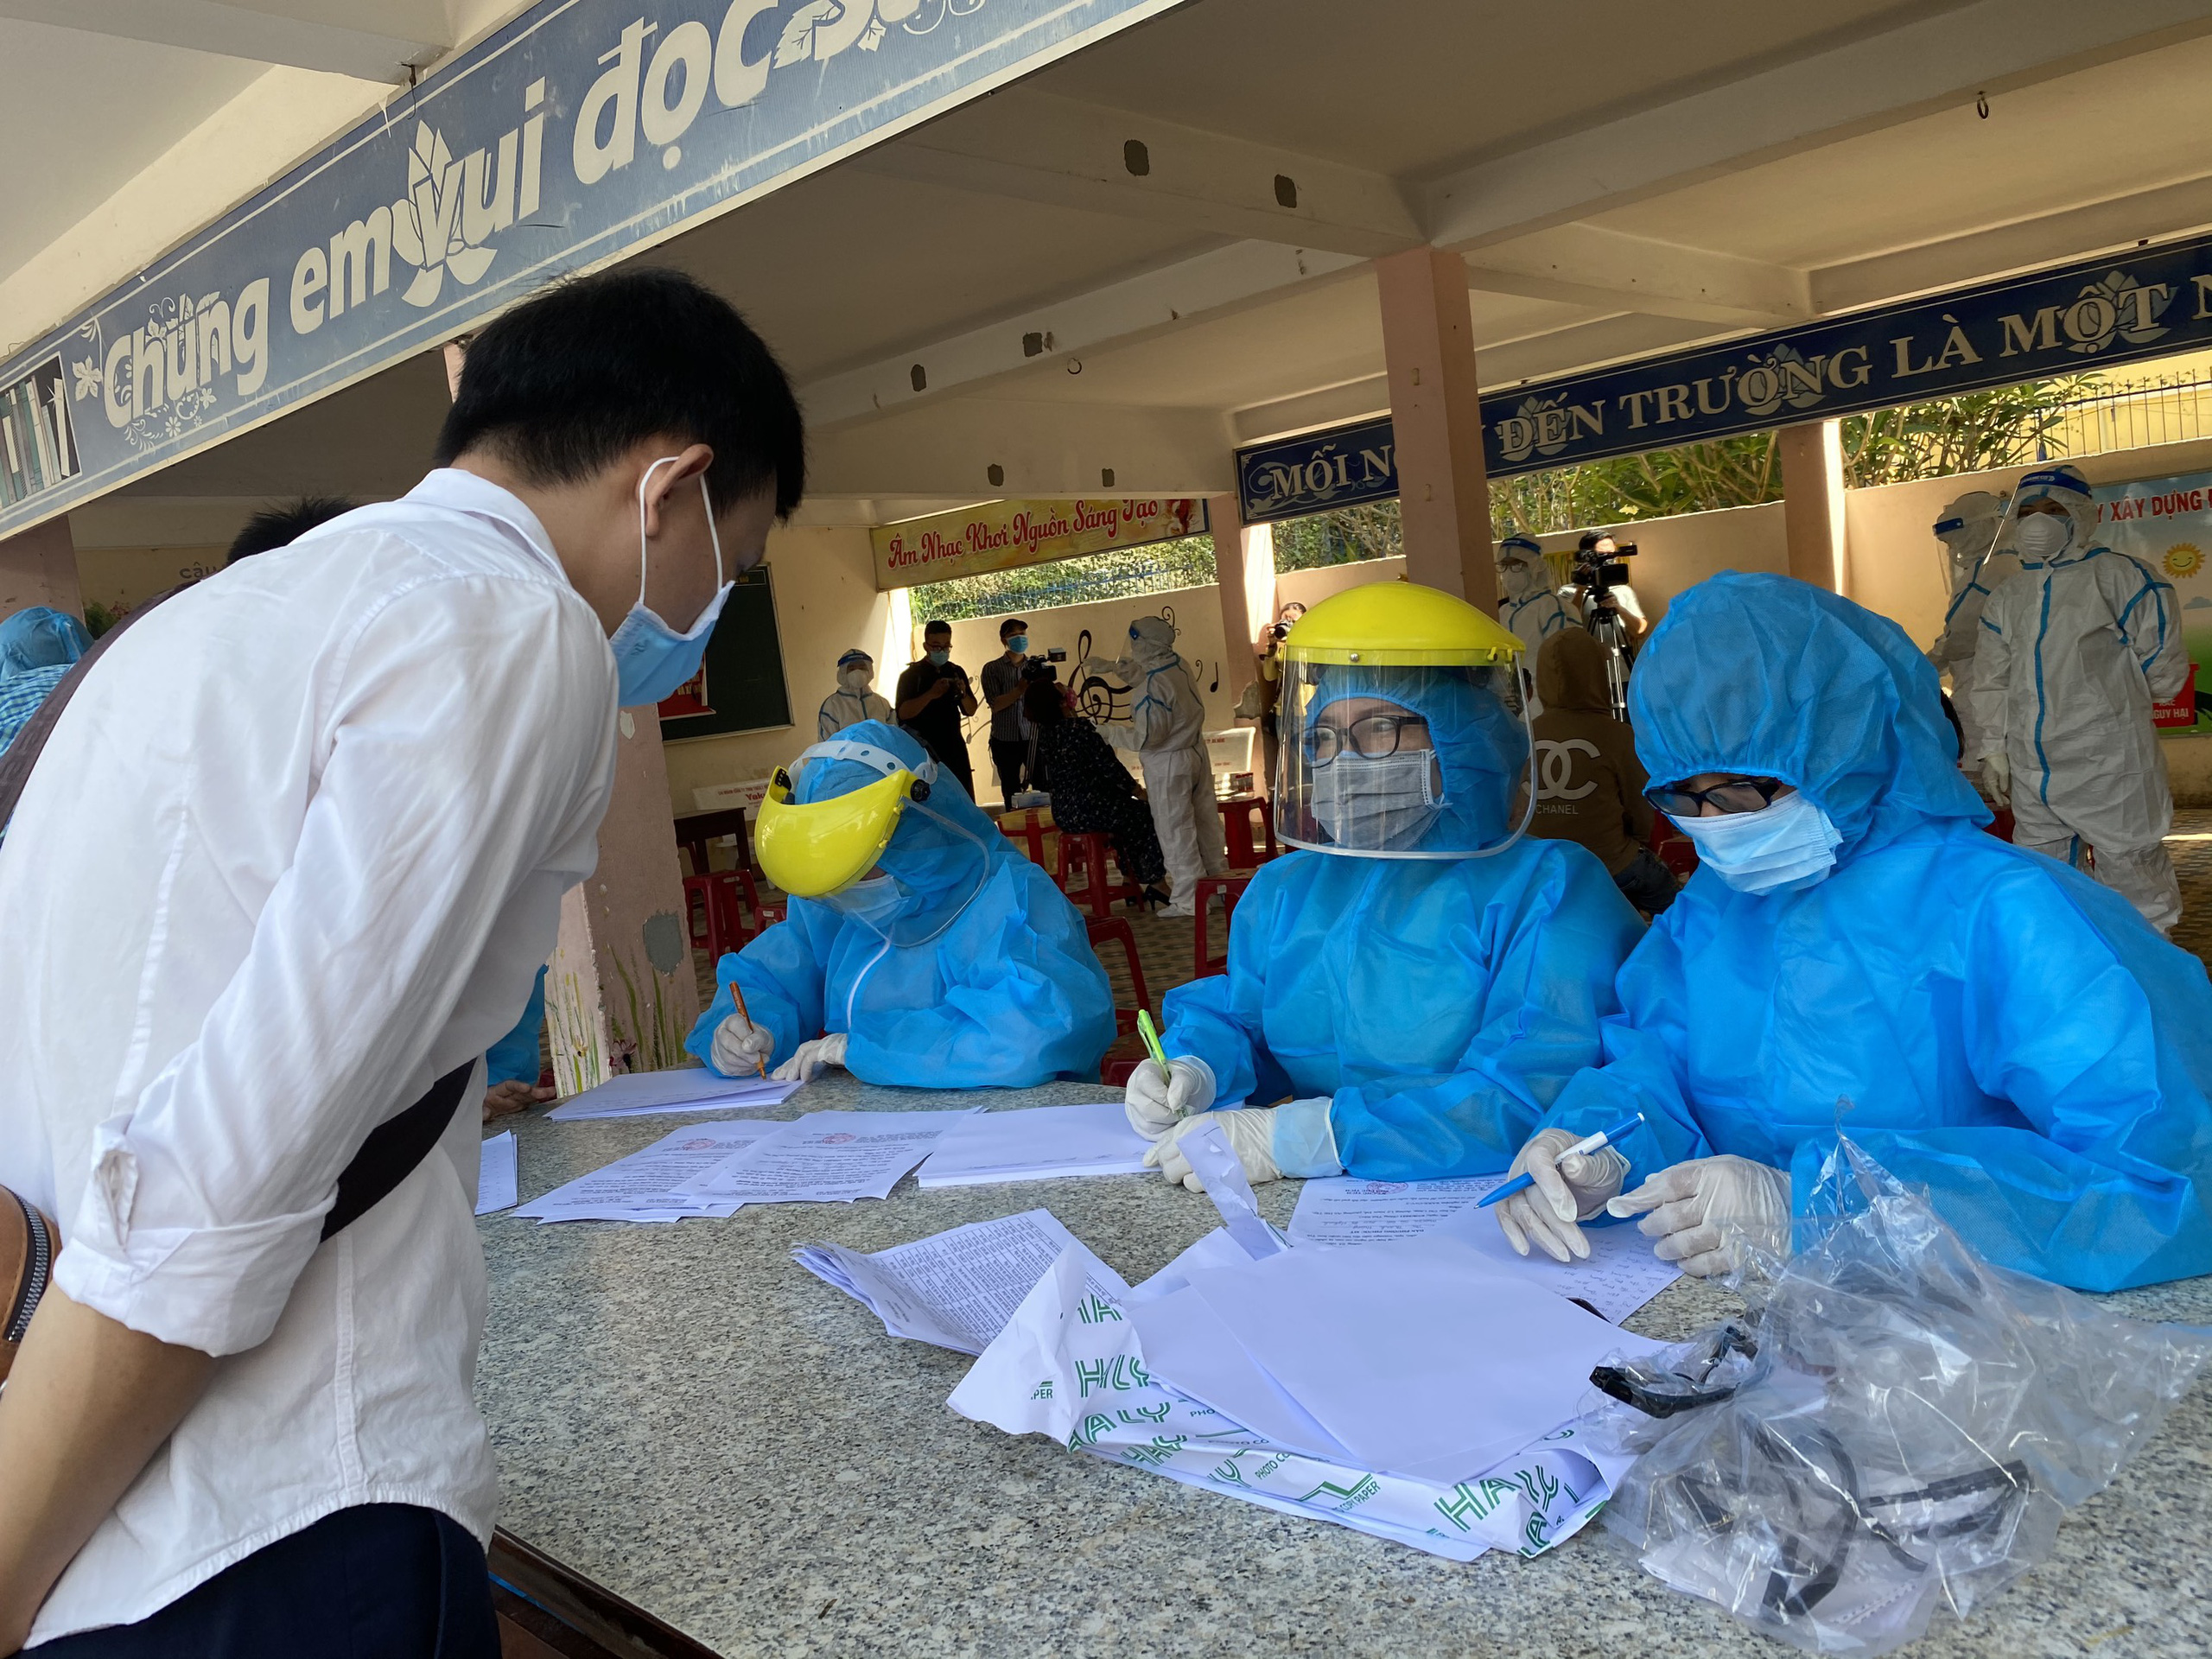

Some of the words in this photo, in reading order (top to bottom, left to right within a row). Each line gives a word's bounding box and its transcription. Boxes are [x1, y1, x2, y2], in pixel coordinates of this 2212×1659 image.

[290, 205, 392, 334] em
[573, 0, 779, 184] đọc
[1497, 392, 1605, 454] ĐẾN
[1618, 346, 1873, 429] TRƯỜNG
[1890, 314, 1983, 378] LÀ
[1998, 283, 2169, 358] MỘT
[1270, 442, 1351, 500] MỖI
[2110, 495, 2145, 521] XÂY
[2152, 489, 2202, 520] DỰNG
[888, 532, 918, 569] Âm
[921, 531, 964, 564] Nhạc
[965, 521, 1009, 552] Khơi
[1012, 506, 1069, 554] Nguồn
[1073, 499, 1117, 538] Sáng
[2154, 709, 2171, 719] GUY
[1535, 804, 1579, 815] CHANEL
[1255, 1459, 1279, 1480] PHOTO
[1353, 1480, 1381, 1504] PAPER
